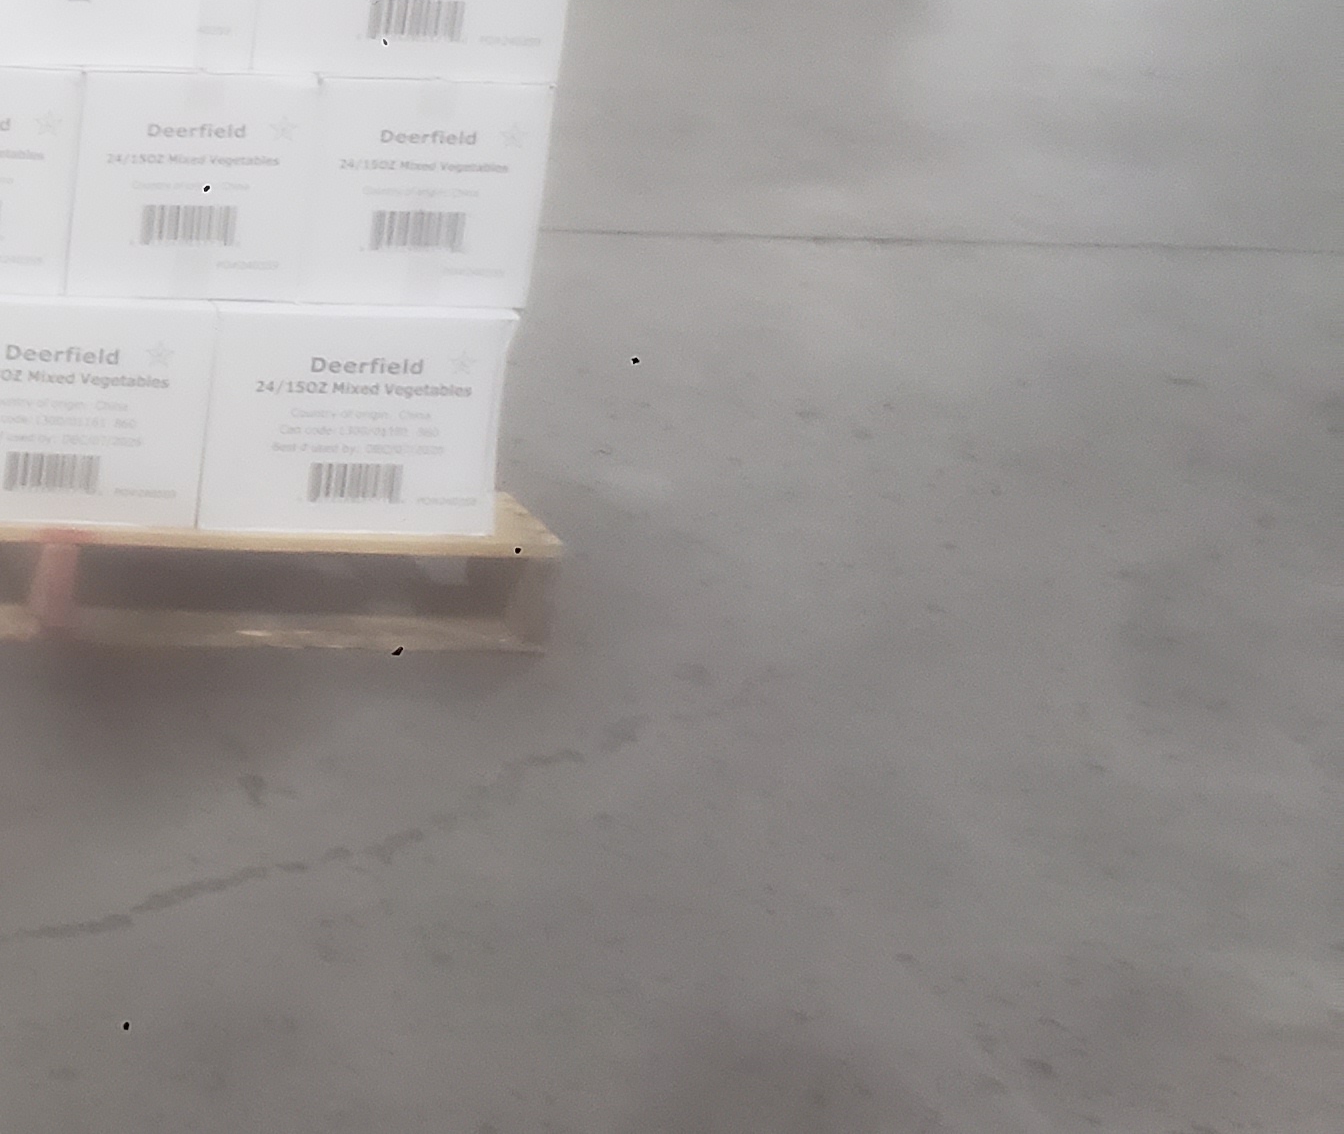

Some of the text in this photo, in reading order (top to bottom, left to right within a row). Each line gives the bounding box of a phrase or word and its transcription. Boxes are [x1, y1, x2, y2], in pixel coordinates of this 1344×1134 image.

[146, 122, 247, 138] Deerfield
[380, 129, 477, 145] Deerfield
[168, 153, 206, 165] Mixed
[210, 155, 280, 167] Vegetables
[400, 161, 436, 171] Mixed
[440, 162, 510, 173] Vegetables
[5, 344, 121, 365] Deerfield
[310, 357, 425, 375] Deerfield
[27, 370, 76, 384] Mixed
[80, 373, 170, 389] Vegetables
[255, 380, 472, 399] 24/15OZ Mixed Vegetables
